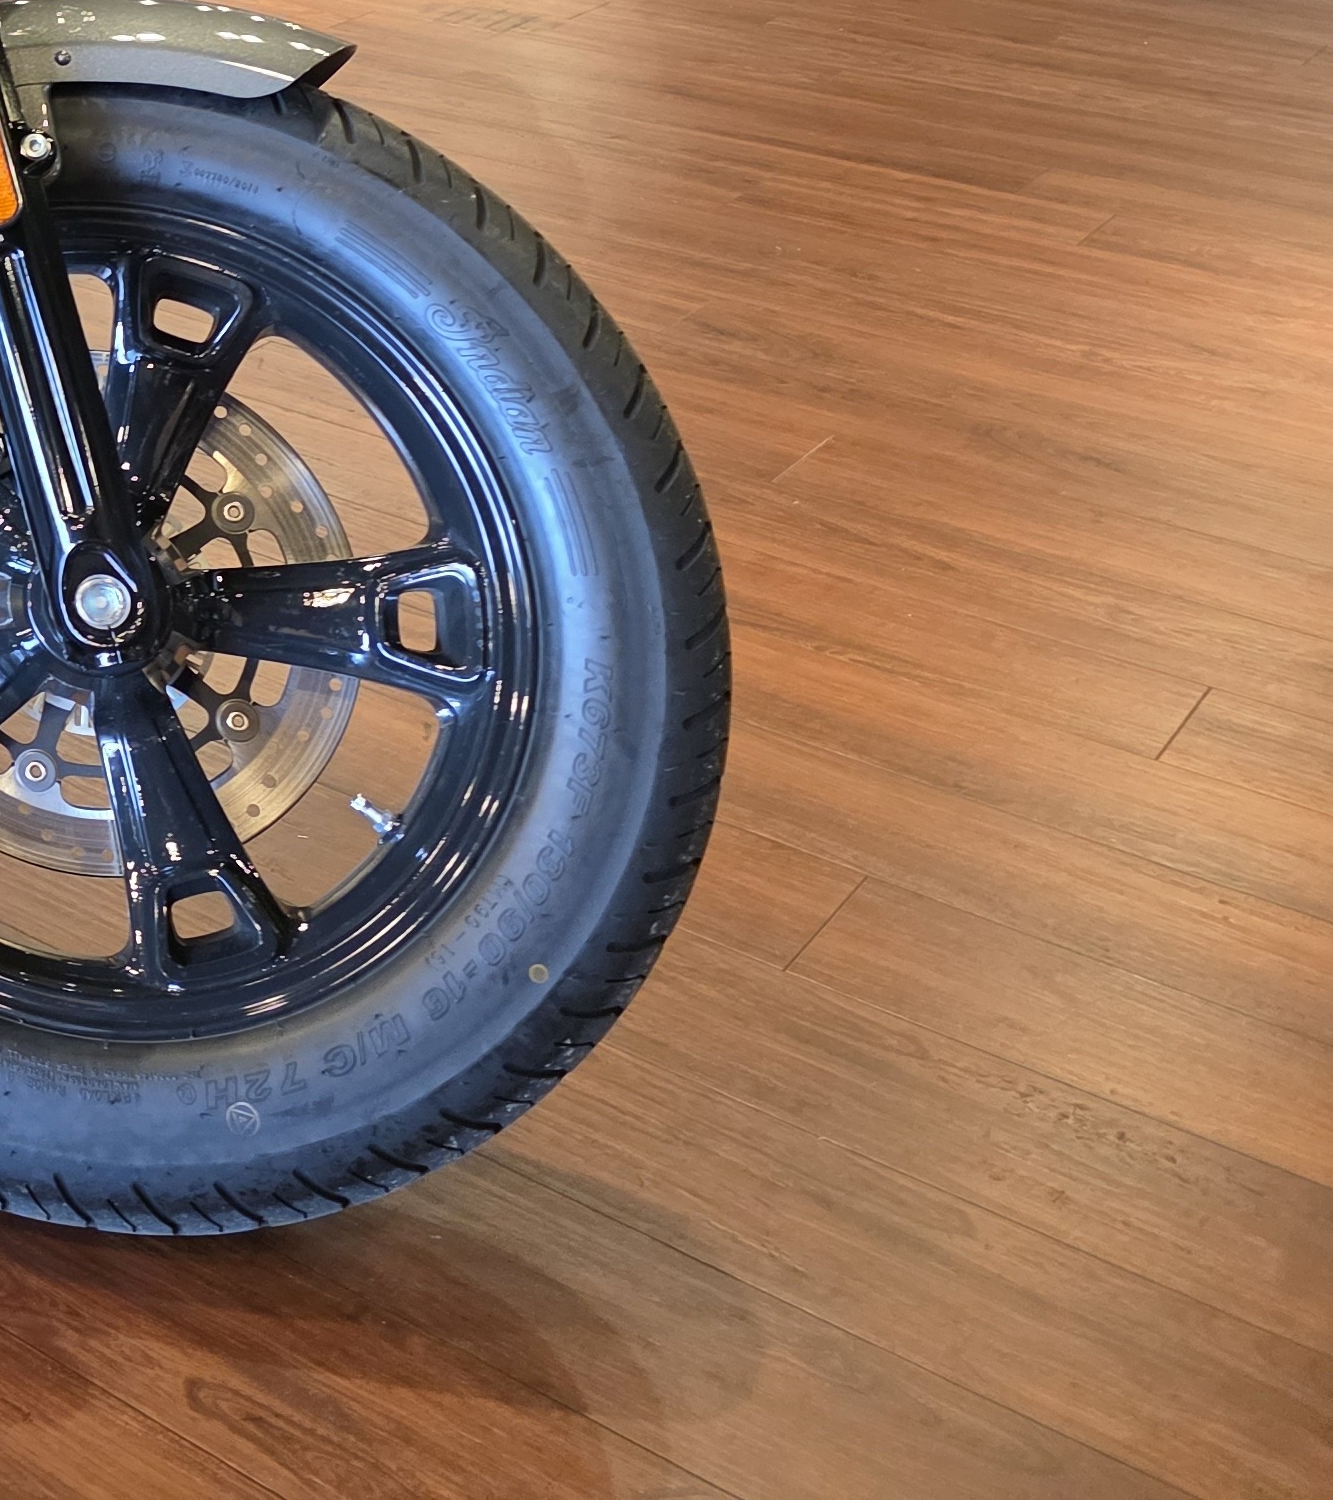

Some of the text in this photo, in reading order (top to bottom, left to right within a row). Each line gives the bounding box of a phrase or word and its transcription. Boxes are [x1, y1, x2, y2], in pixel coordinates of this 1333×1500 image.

[425, 303, 553, 456] Indian
[205, 657, 610, 1116] K673F 130/90-16 M/C 72H
